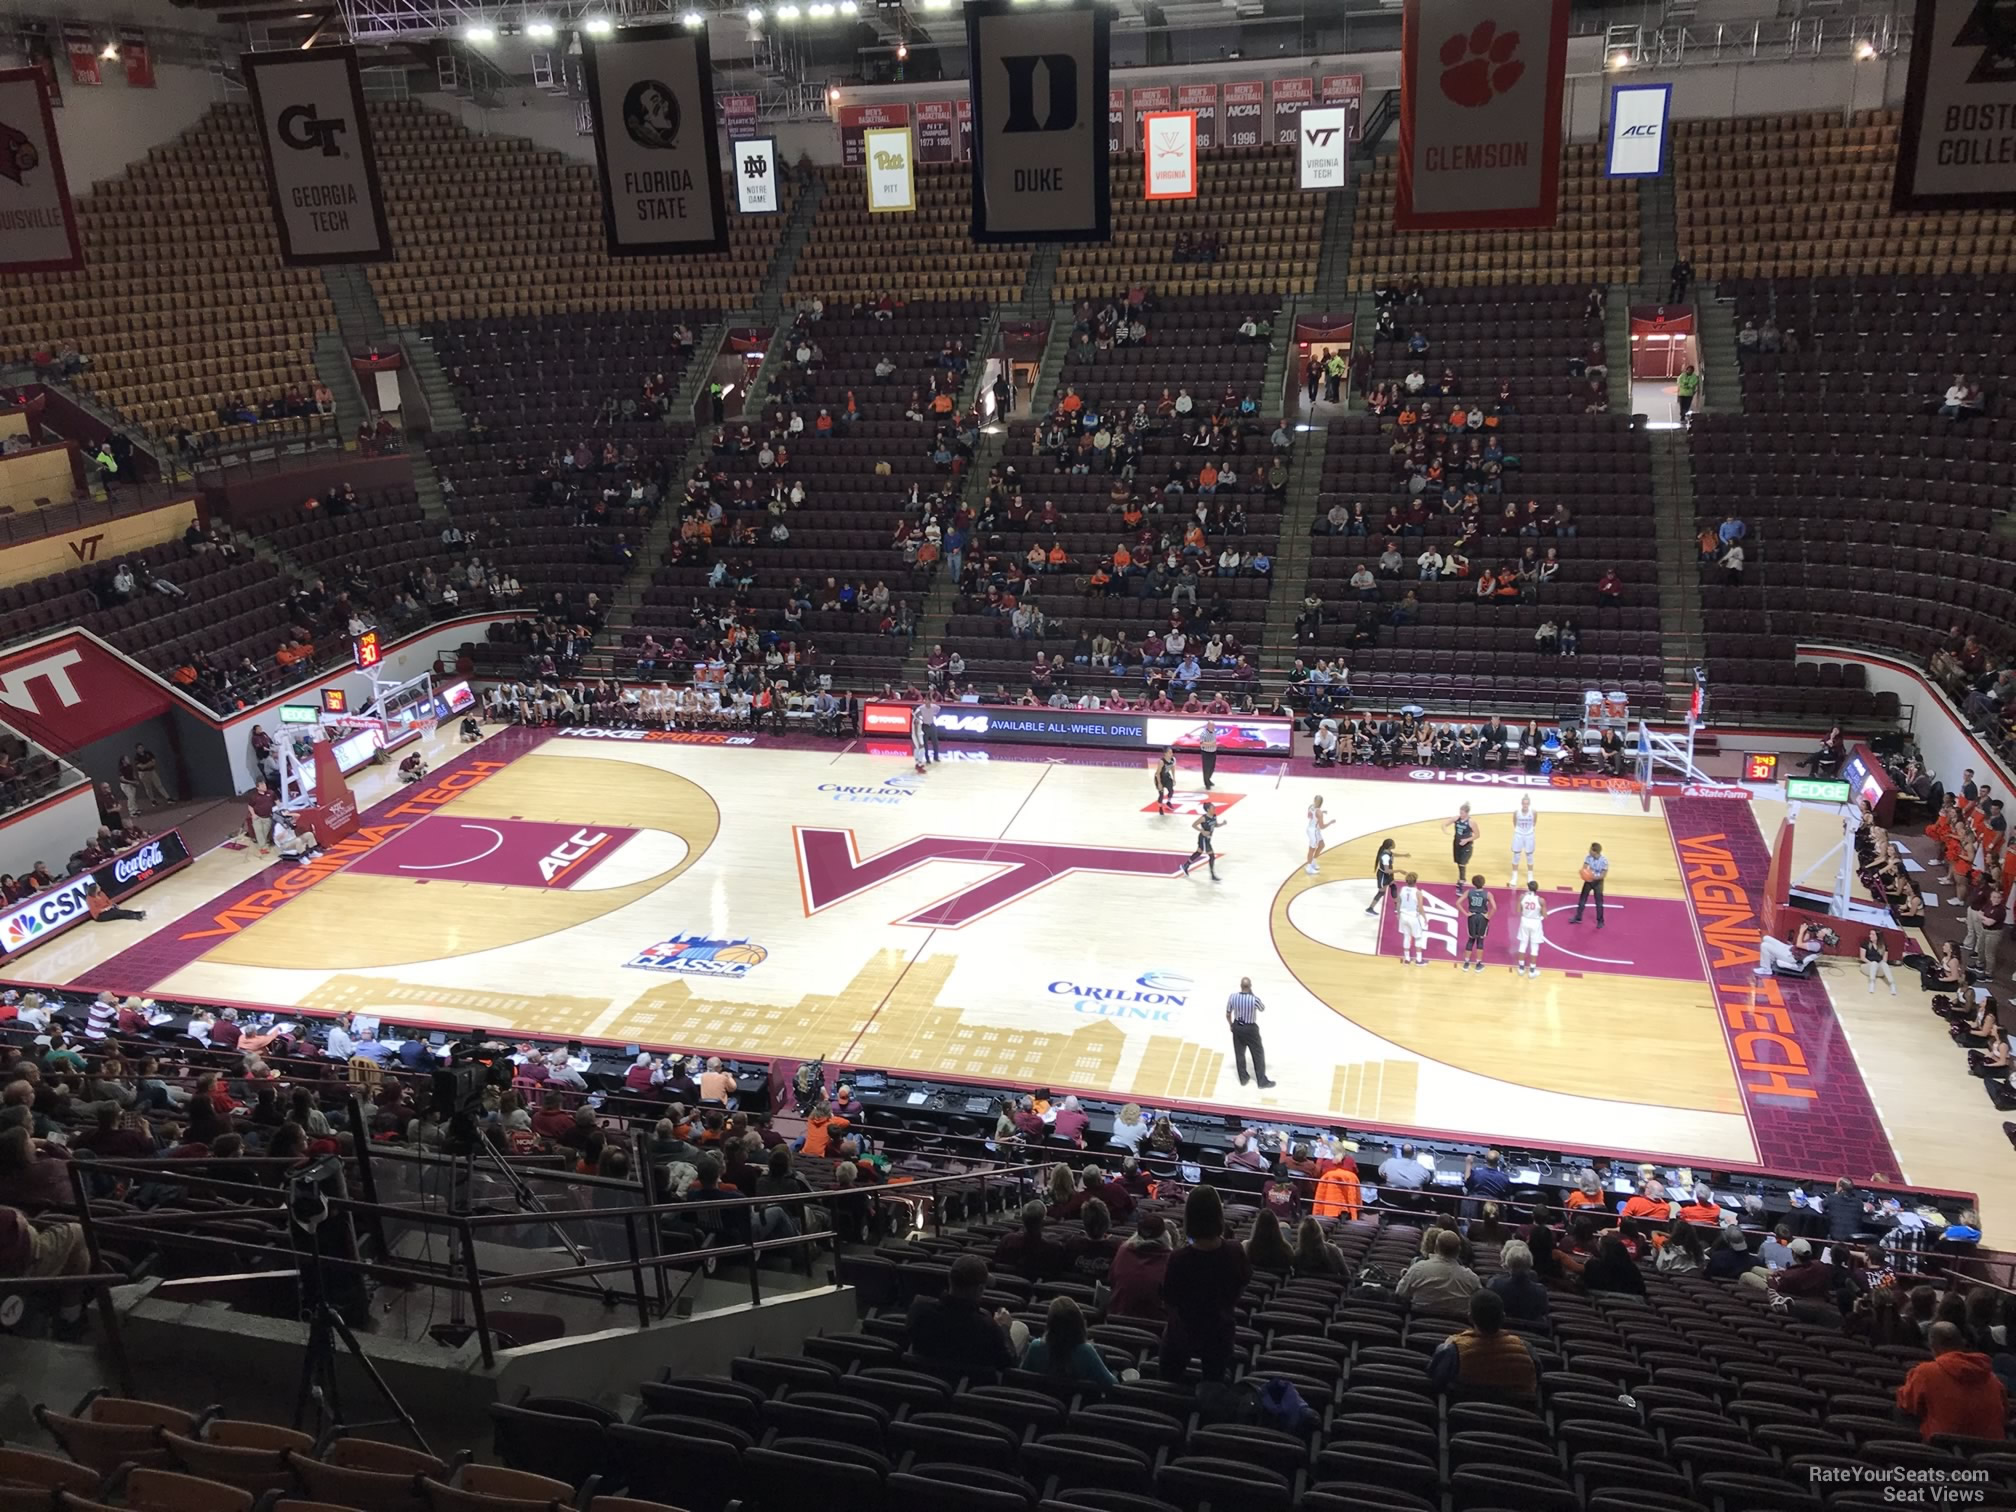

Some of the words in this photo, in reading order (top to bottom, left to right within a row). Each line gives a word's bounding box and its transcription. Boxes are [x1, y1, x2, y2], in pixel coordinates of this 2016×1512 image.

[1234, 85, 1253, 93] MEN'S
[1275, 89, 1310, 98] BASKETBALL
[1282, 82, 1302, 90] MEN'S
[1324, 86, 1360, 95] BASKETBALL
[1226, 92, 1260, 100] BASKETBALL
[1227, 104, 1260, 117] NCAA
[1232, 132, 1256, 145] 1996
[1305, 128, 1341, 147] VT
[1622, 125, 1659, 136] ACC
[920, 138, 934, 147] 1973
[1938, 136, 2016, 166] COLLE
[1307, 158, 1339, 168] VIRGINIA
[1426, 142, 1528, 172] CLEMSON
[624, 169, 693, 194] FLORIDA
[1014, 168, 1063, 192] DUKE
[1155, 170, 1187, 180] VIRGINIA
[1314, 169, 1333, 179] TECH
[292, 184, 358, 208] GEORGIA
[747, 185, 767, 195] NOTRE
[884, 184, 898, 193] PITT
[749, 195, 767, 204] DAME
[637, 197, 687, 221] STATE
[310, 210, 350, 232] TECH
[68, 534, 104, 562] VT
[361, 645, 376, 665] 30
[991, 720, 1045, 731] AVAILABLE
[1048, 723, 1107, 735] ALL-WHEEL
[1111, 726, 1142, 737] DRIVE
[1752, 765, 1768, 778] 30
[385, 761, 506, 818] TECH
[818, 783, 917, 796] CARILION
[1800, 783, 1846, 799] EDGE
[115, 842, 163, 883] Coca-Cola
[538, 828, 608, 881] ACC
[178, 822, 409, 942] VIRGINIA
[1525, 902, 1536, 910] 20
[1678, 833, 1762, 968] VIRGINIA
[628, 955, 753, 975] CLASSIC
[1048, 981, 1189, 1006] CARILION
[1074, 999, 1177, 1022] CLINIC
[1719, 979, 1818, 1099] TECH
